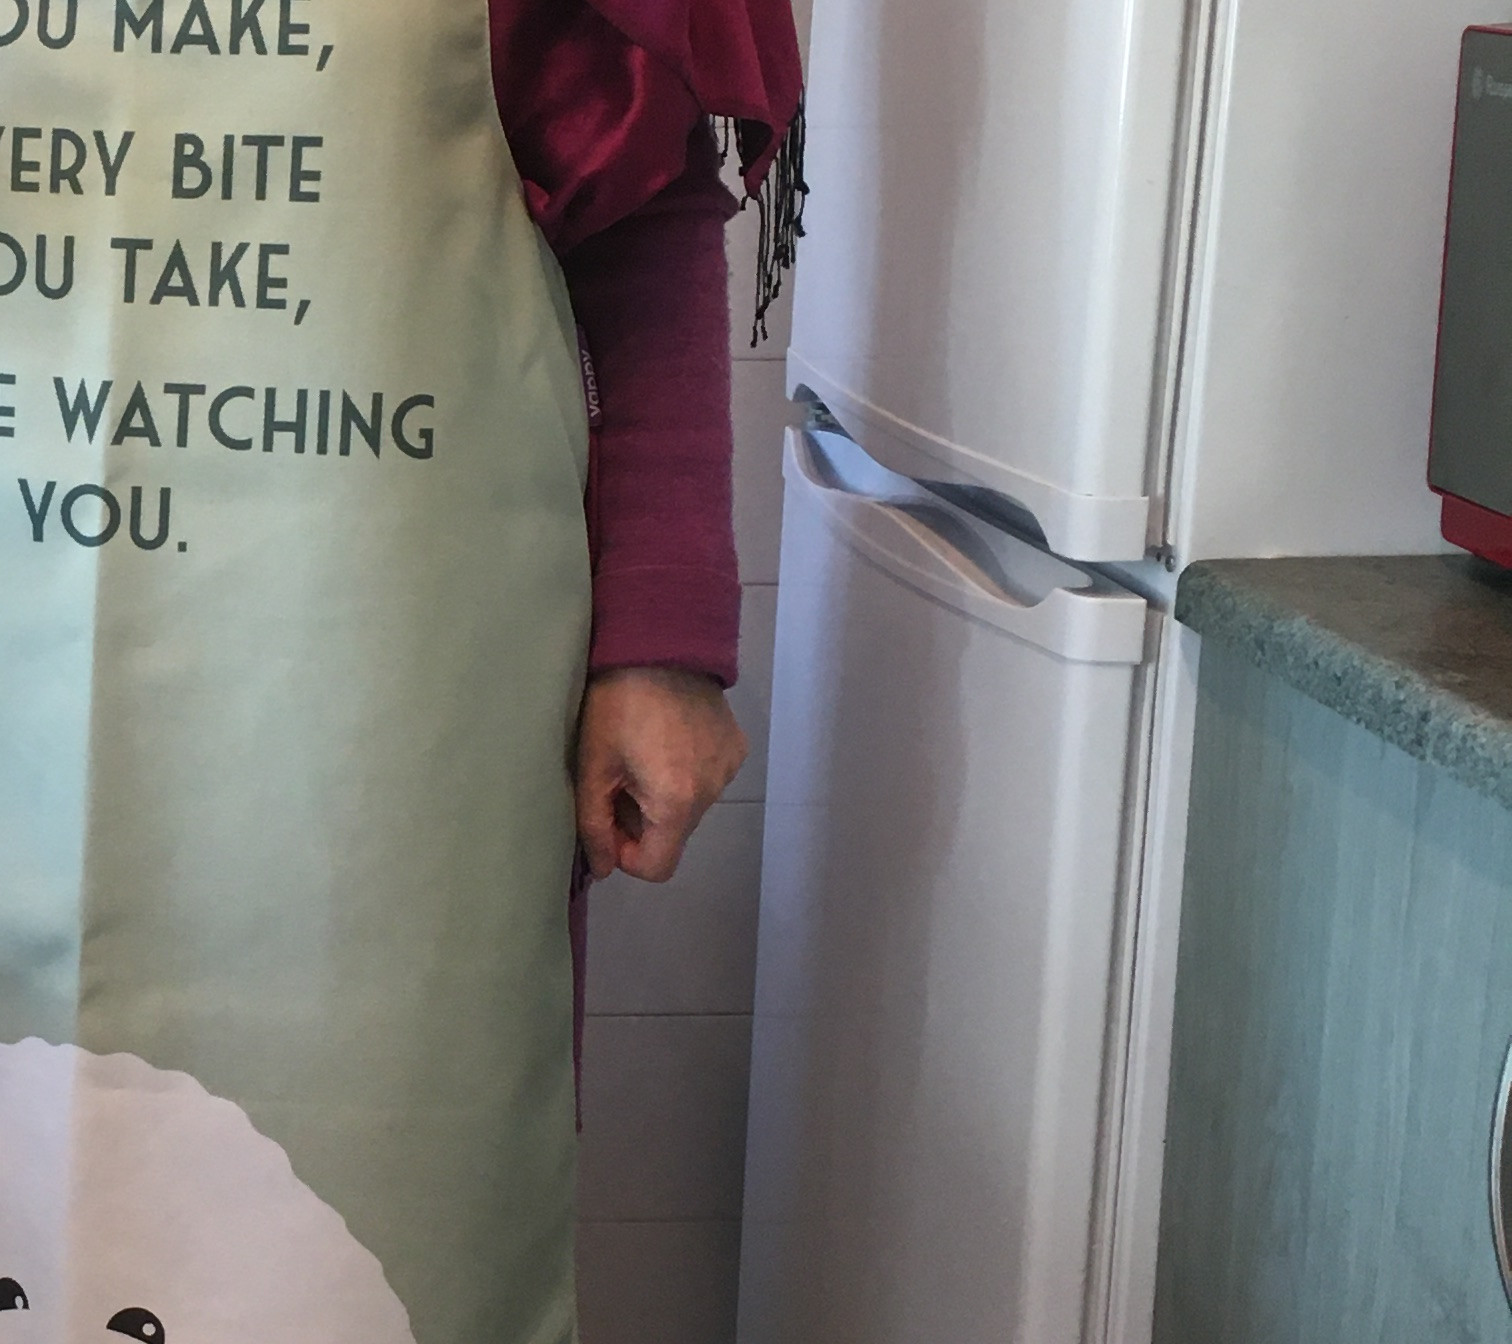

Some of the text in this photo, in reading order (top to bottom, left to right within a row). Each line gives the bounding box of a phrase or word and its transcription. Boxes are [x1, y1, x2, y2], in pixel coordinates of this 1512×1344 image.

[171, 132, 324, 203] BITE
[110, 236, 312, 326] TAKE,
[53, 375, 436, 461] WATCHING
[17, 478, 188, 553] YOU.
